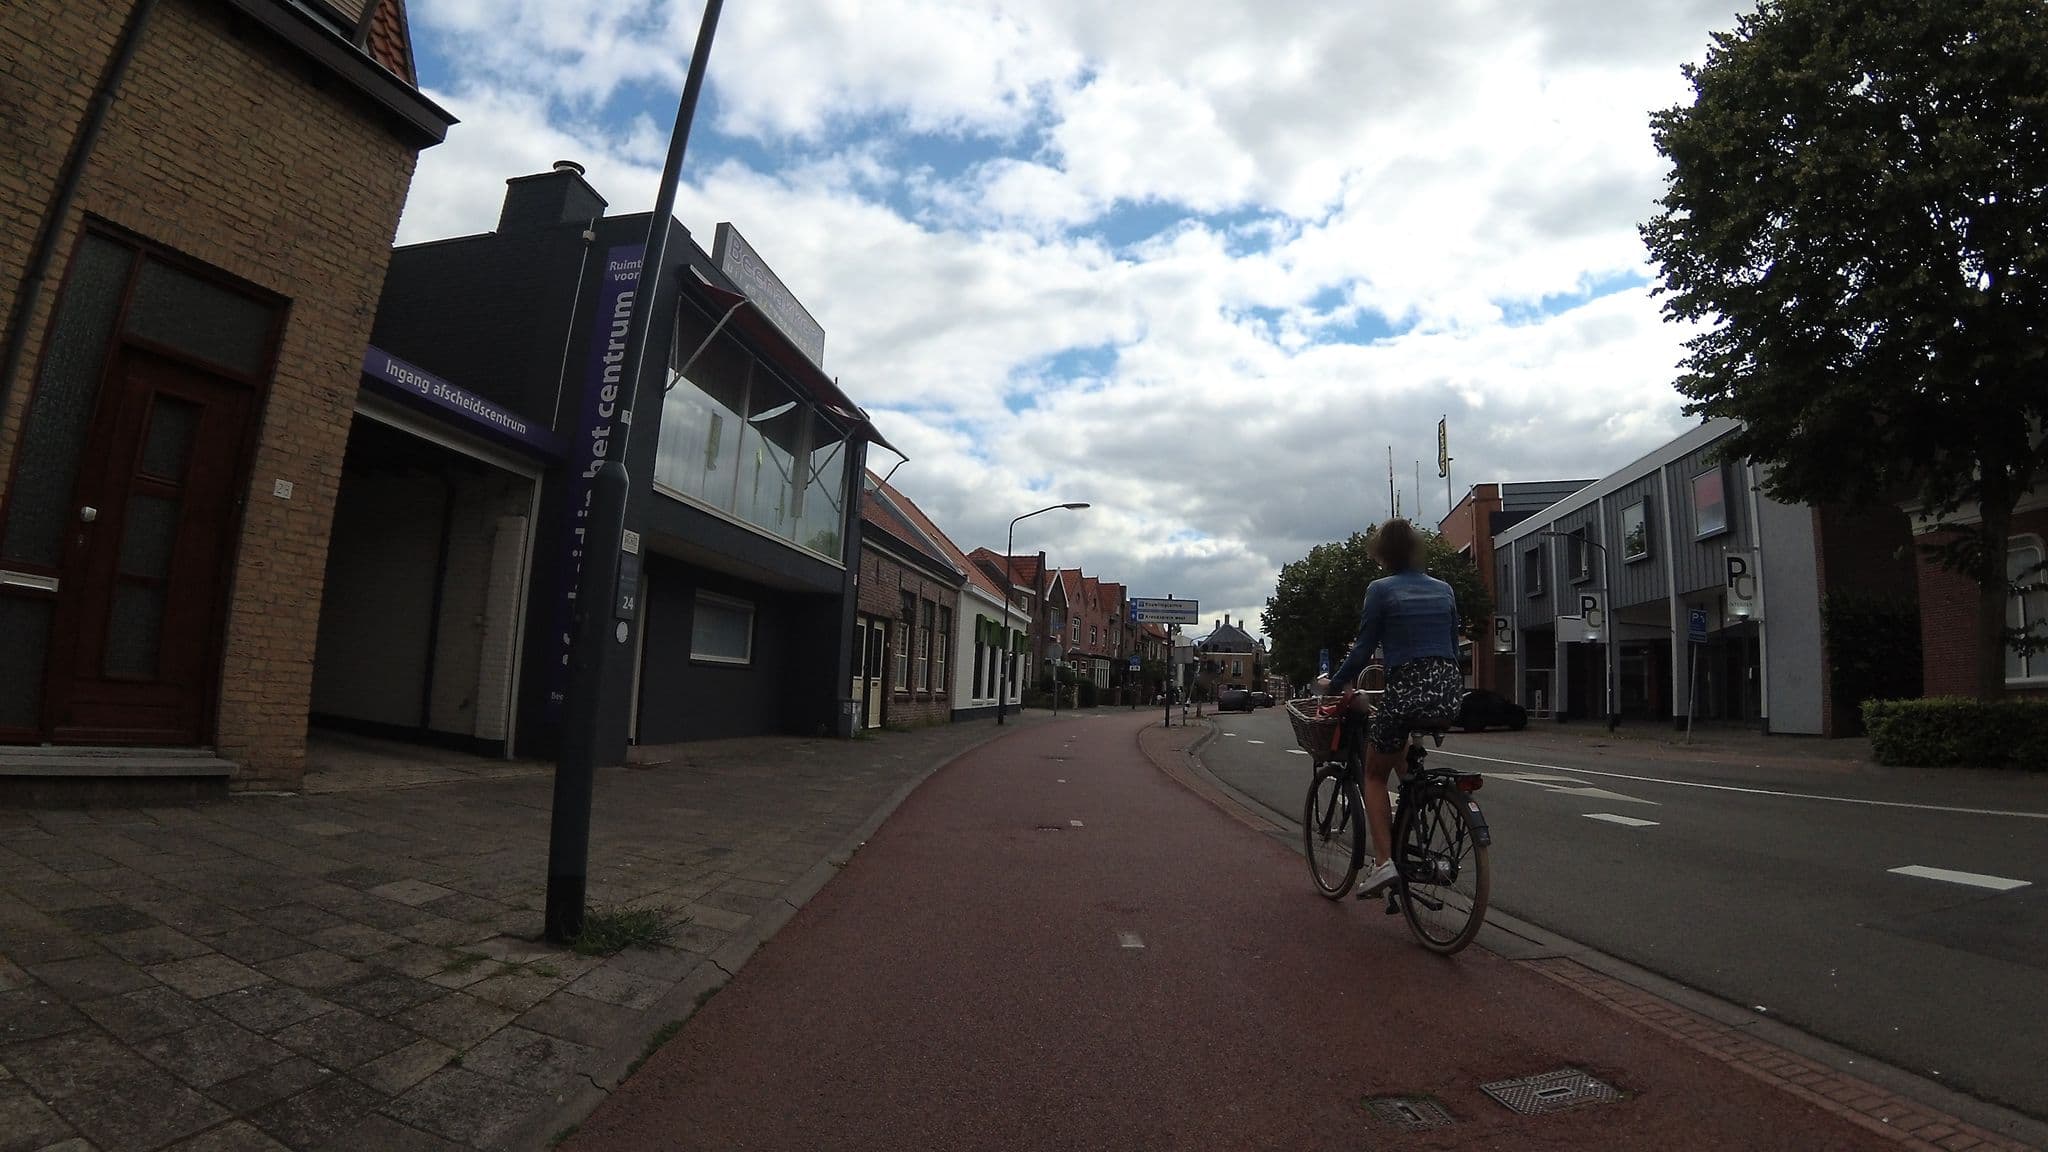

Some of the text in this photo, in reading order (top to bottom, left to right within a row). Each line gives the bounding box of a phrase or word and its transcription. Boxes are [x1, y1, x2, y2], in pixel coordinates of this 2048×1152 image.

[610, 259, 643, 271] Ruimt
[614, 271, 640, 281] voor
[598, 291, 634, 418] centrum
[385, 359, 527, 435] Ingang afscheidscentrum
[622, 596, 634, 610] 24
